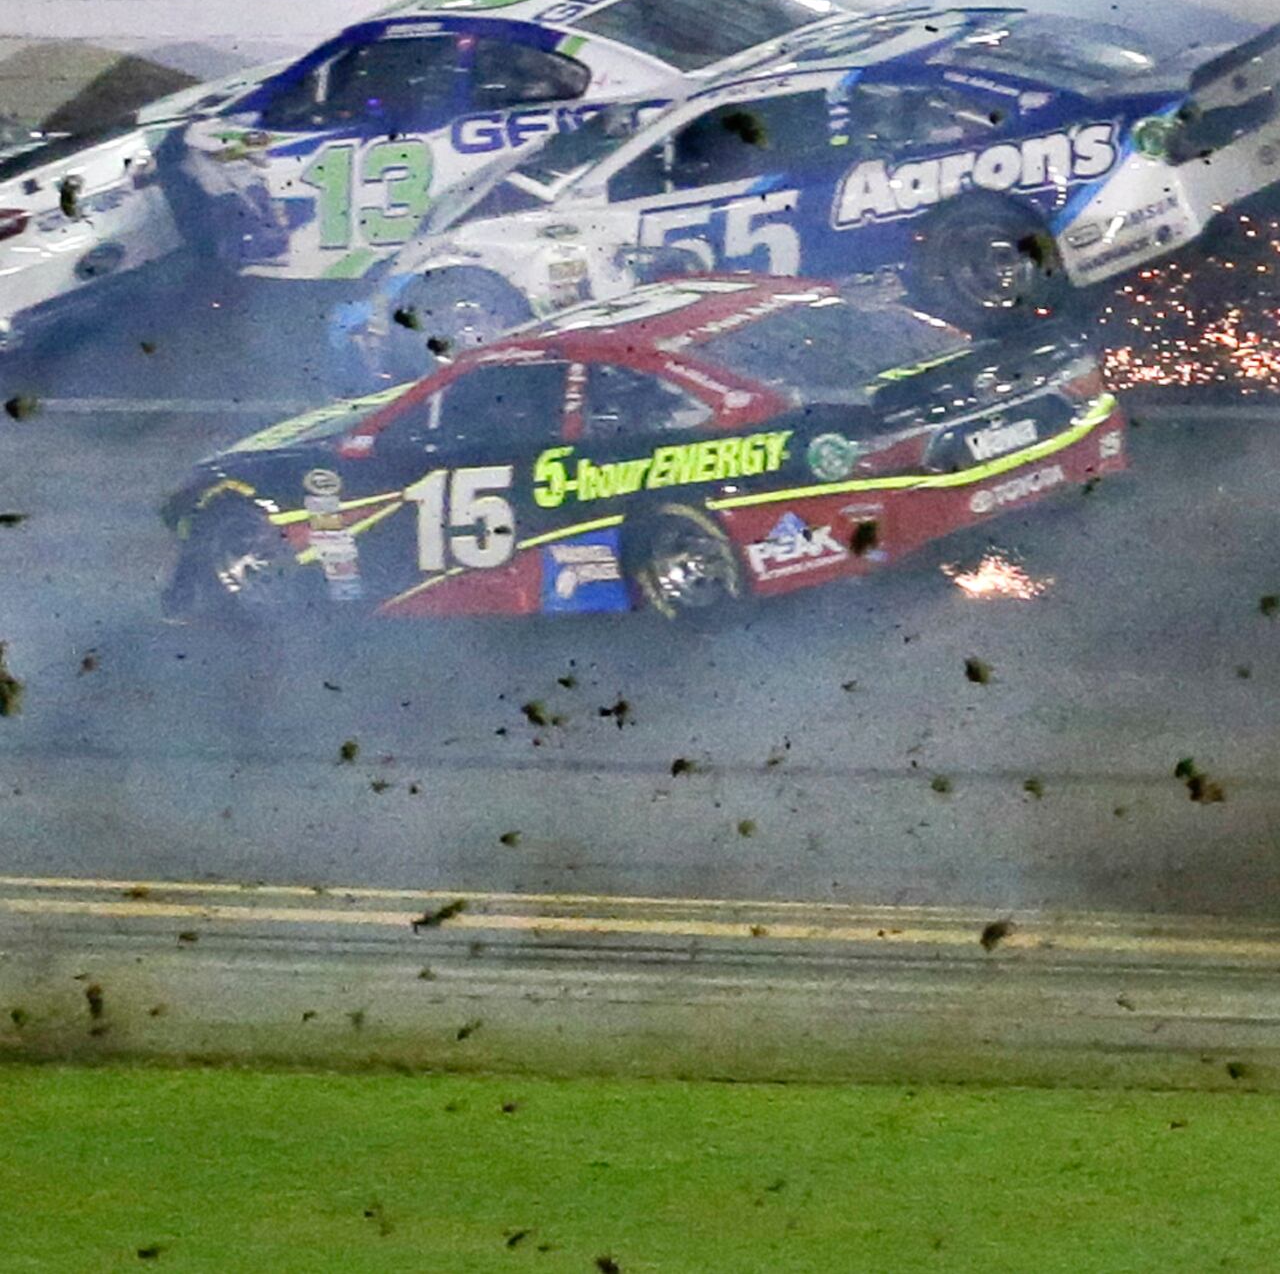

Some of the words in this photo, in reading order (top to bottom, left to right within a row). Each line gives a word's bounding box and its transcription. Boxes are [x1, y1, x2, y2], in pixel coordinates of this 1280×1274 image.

[300, 136, 434, 252] 13
[835, 123, 1117, 226] Aaron's
[636, 190, 800, 280] 55
[402, 464, 515, 572] 15
[533, 445, 653, 509] 5-hour
[646, 430, 795, 490] ENERGY
